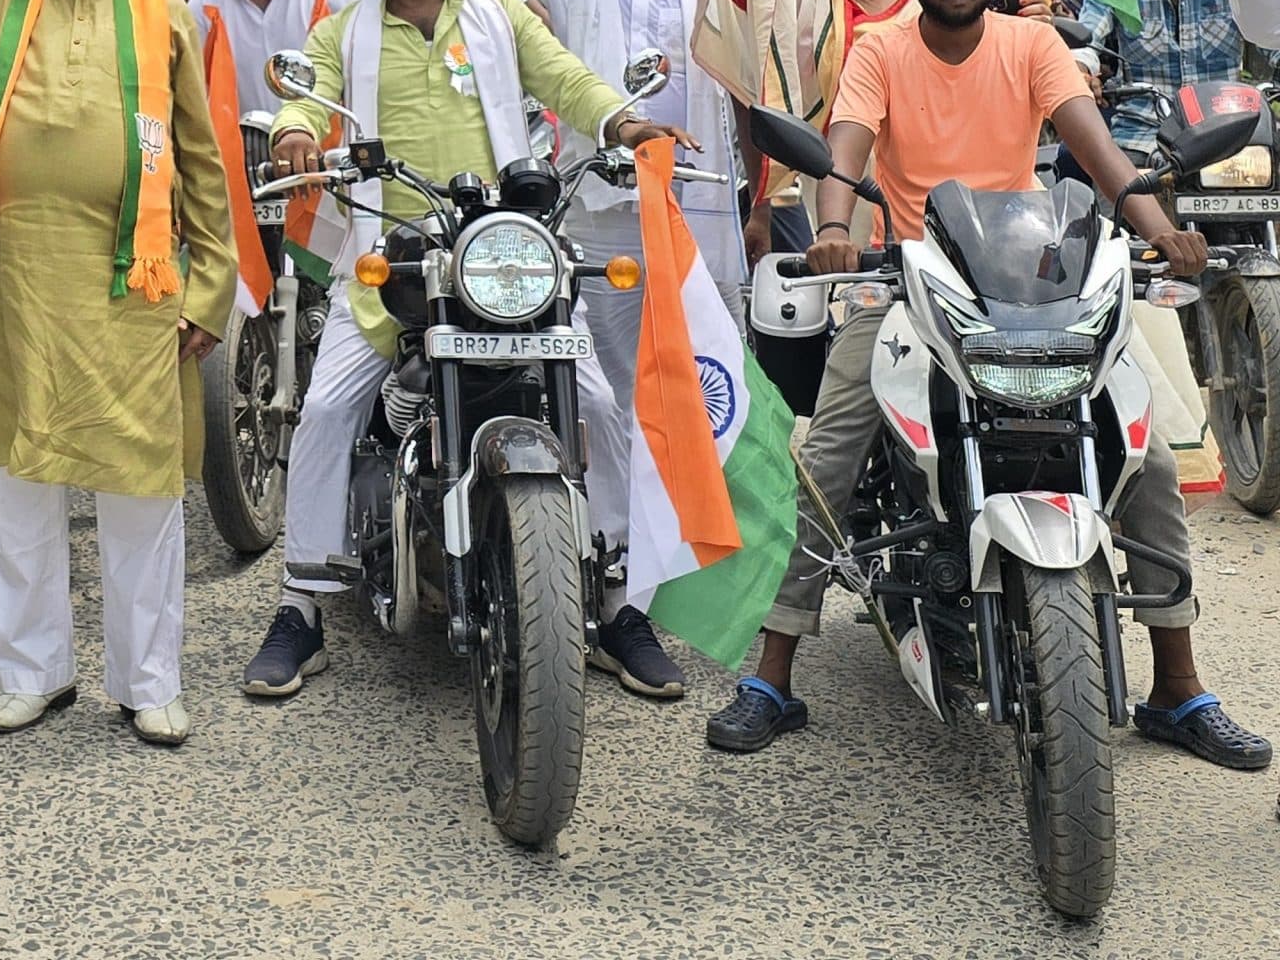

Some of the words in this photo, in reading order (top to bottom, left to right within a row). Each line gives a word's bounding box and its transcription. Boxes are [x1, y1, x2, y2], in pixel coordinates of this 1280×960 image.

[453, 337, 499, 355] BR37
[509, 337, 531, 355] AF
[541, 338, 588, 356] 5626
